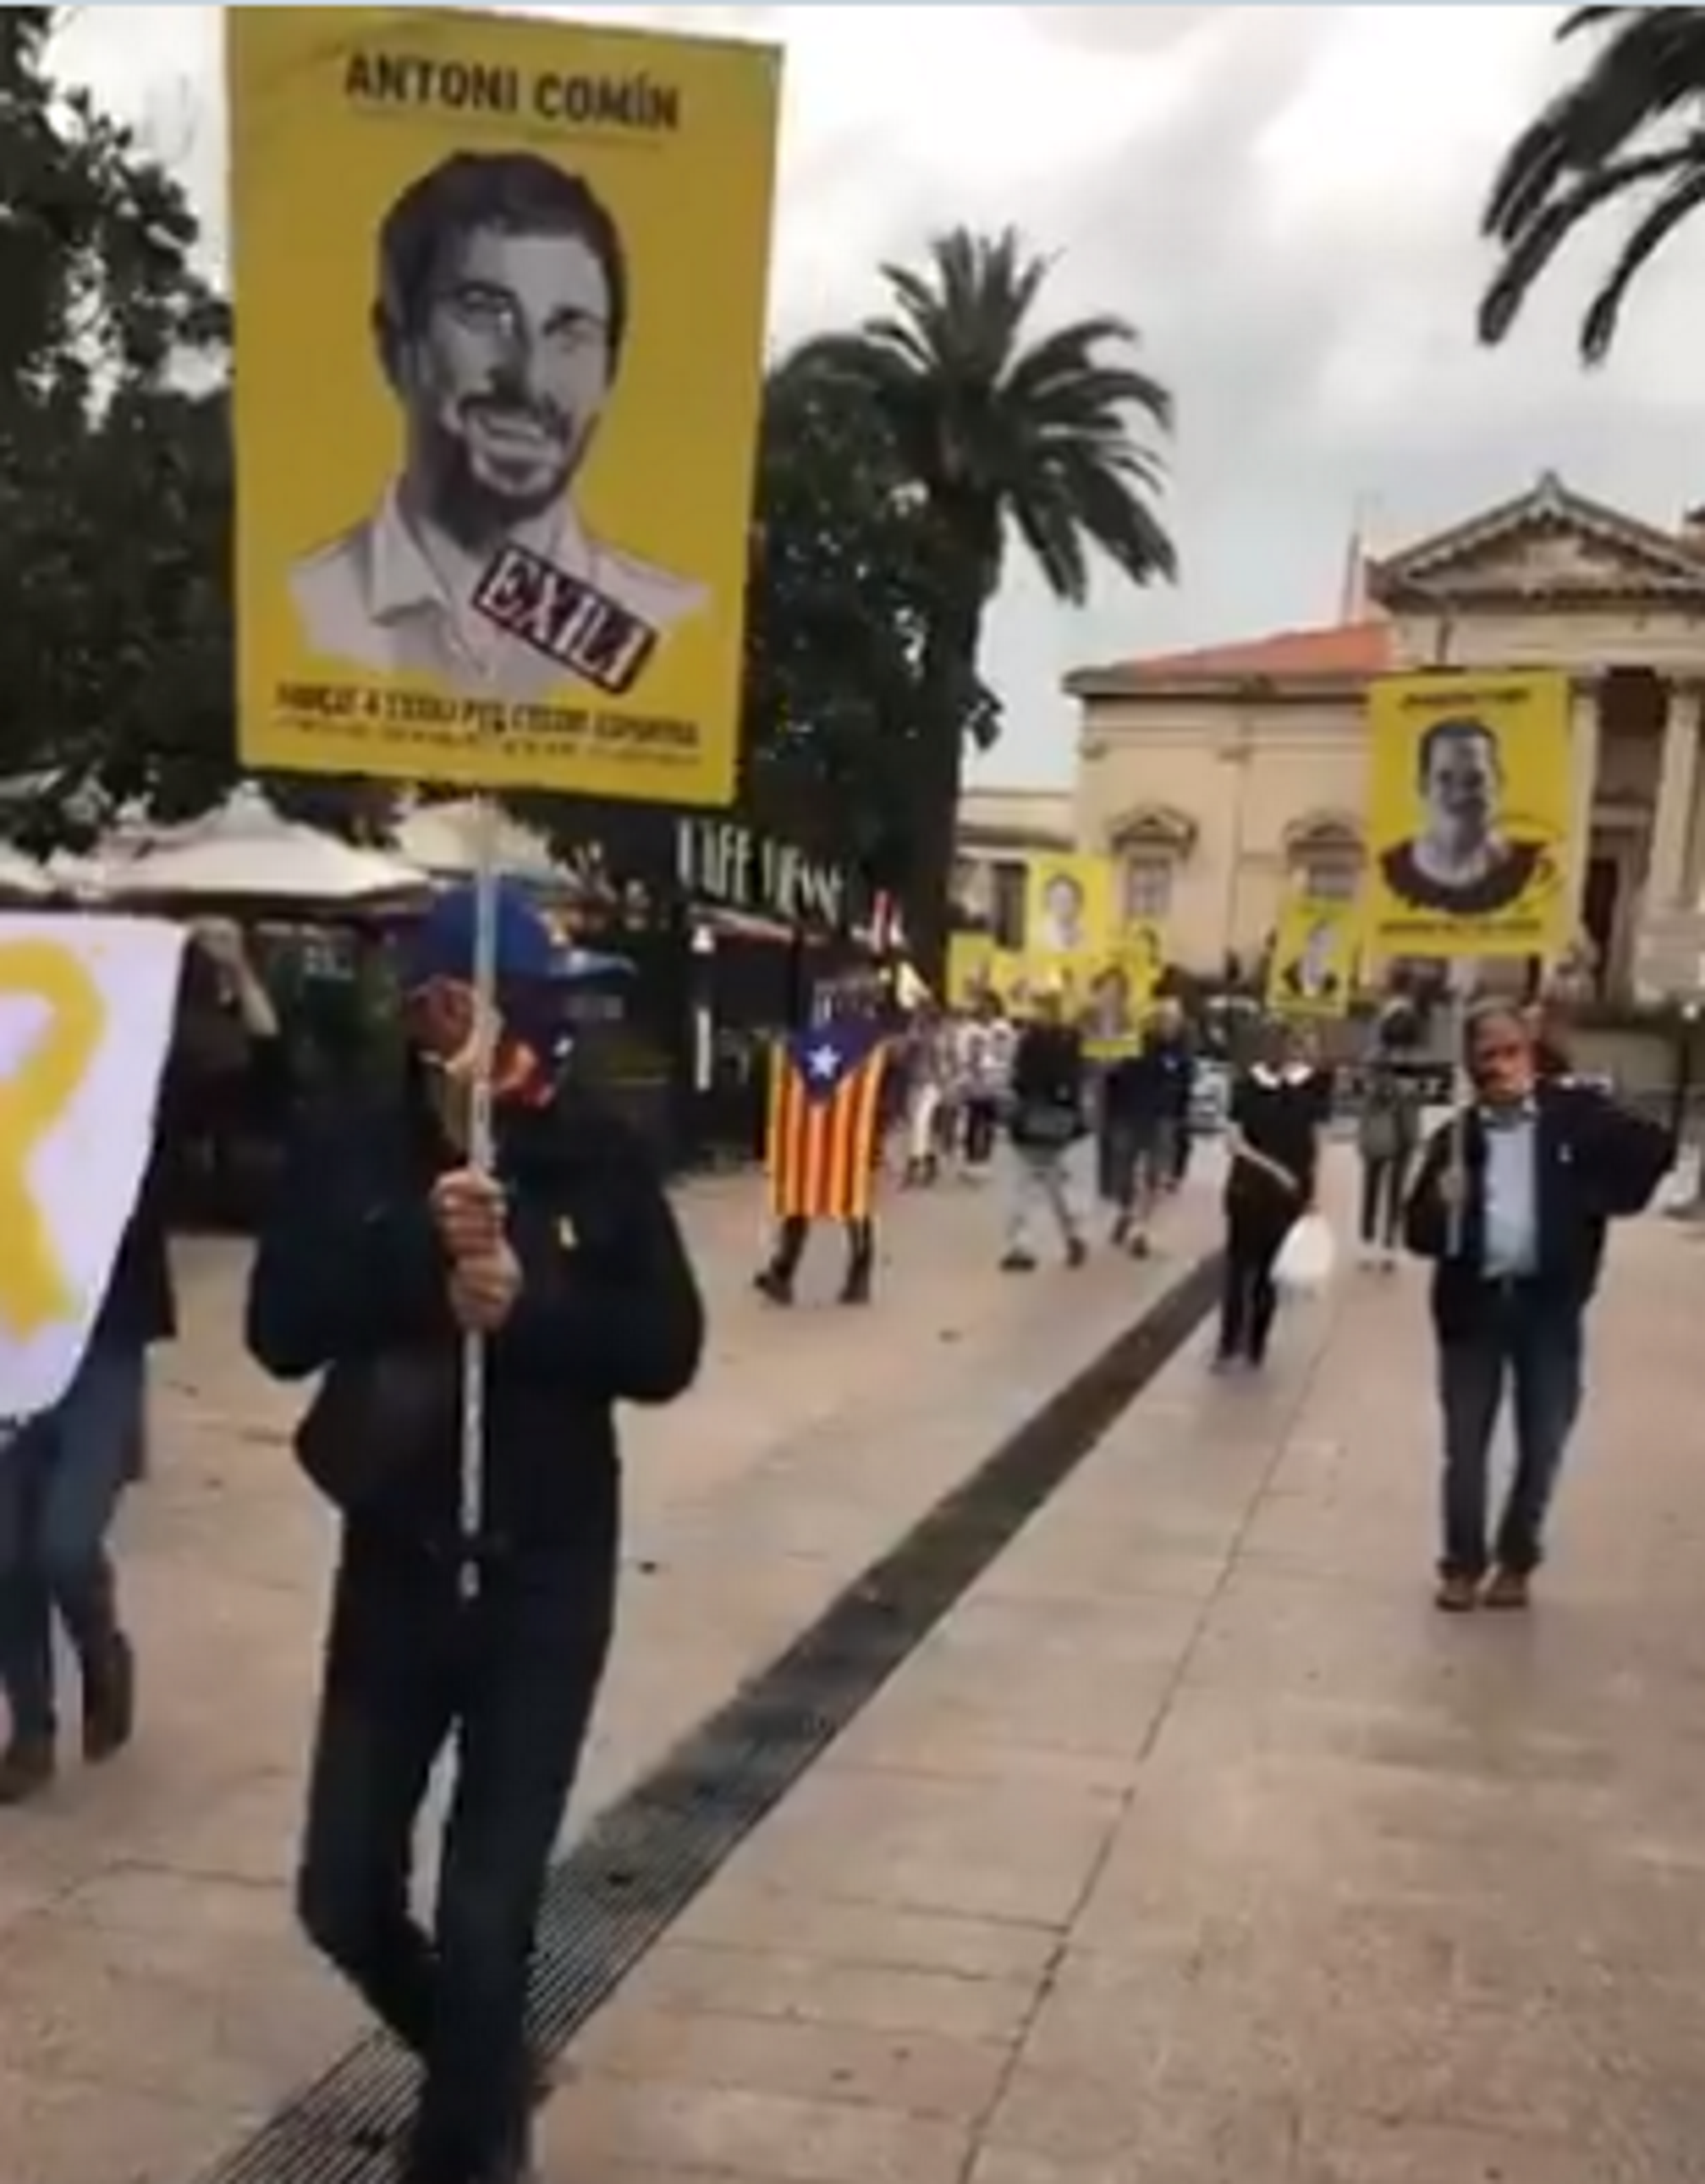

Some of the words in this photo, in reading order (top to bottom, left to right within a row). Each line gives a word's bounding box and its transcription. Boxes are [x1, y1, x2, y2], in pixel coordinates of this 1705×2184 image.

[345, 51, 519, 113] ANTONI
[533, 71, 680, 130] COMÍN
[479, 549, 647, 685] EXILI
